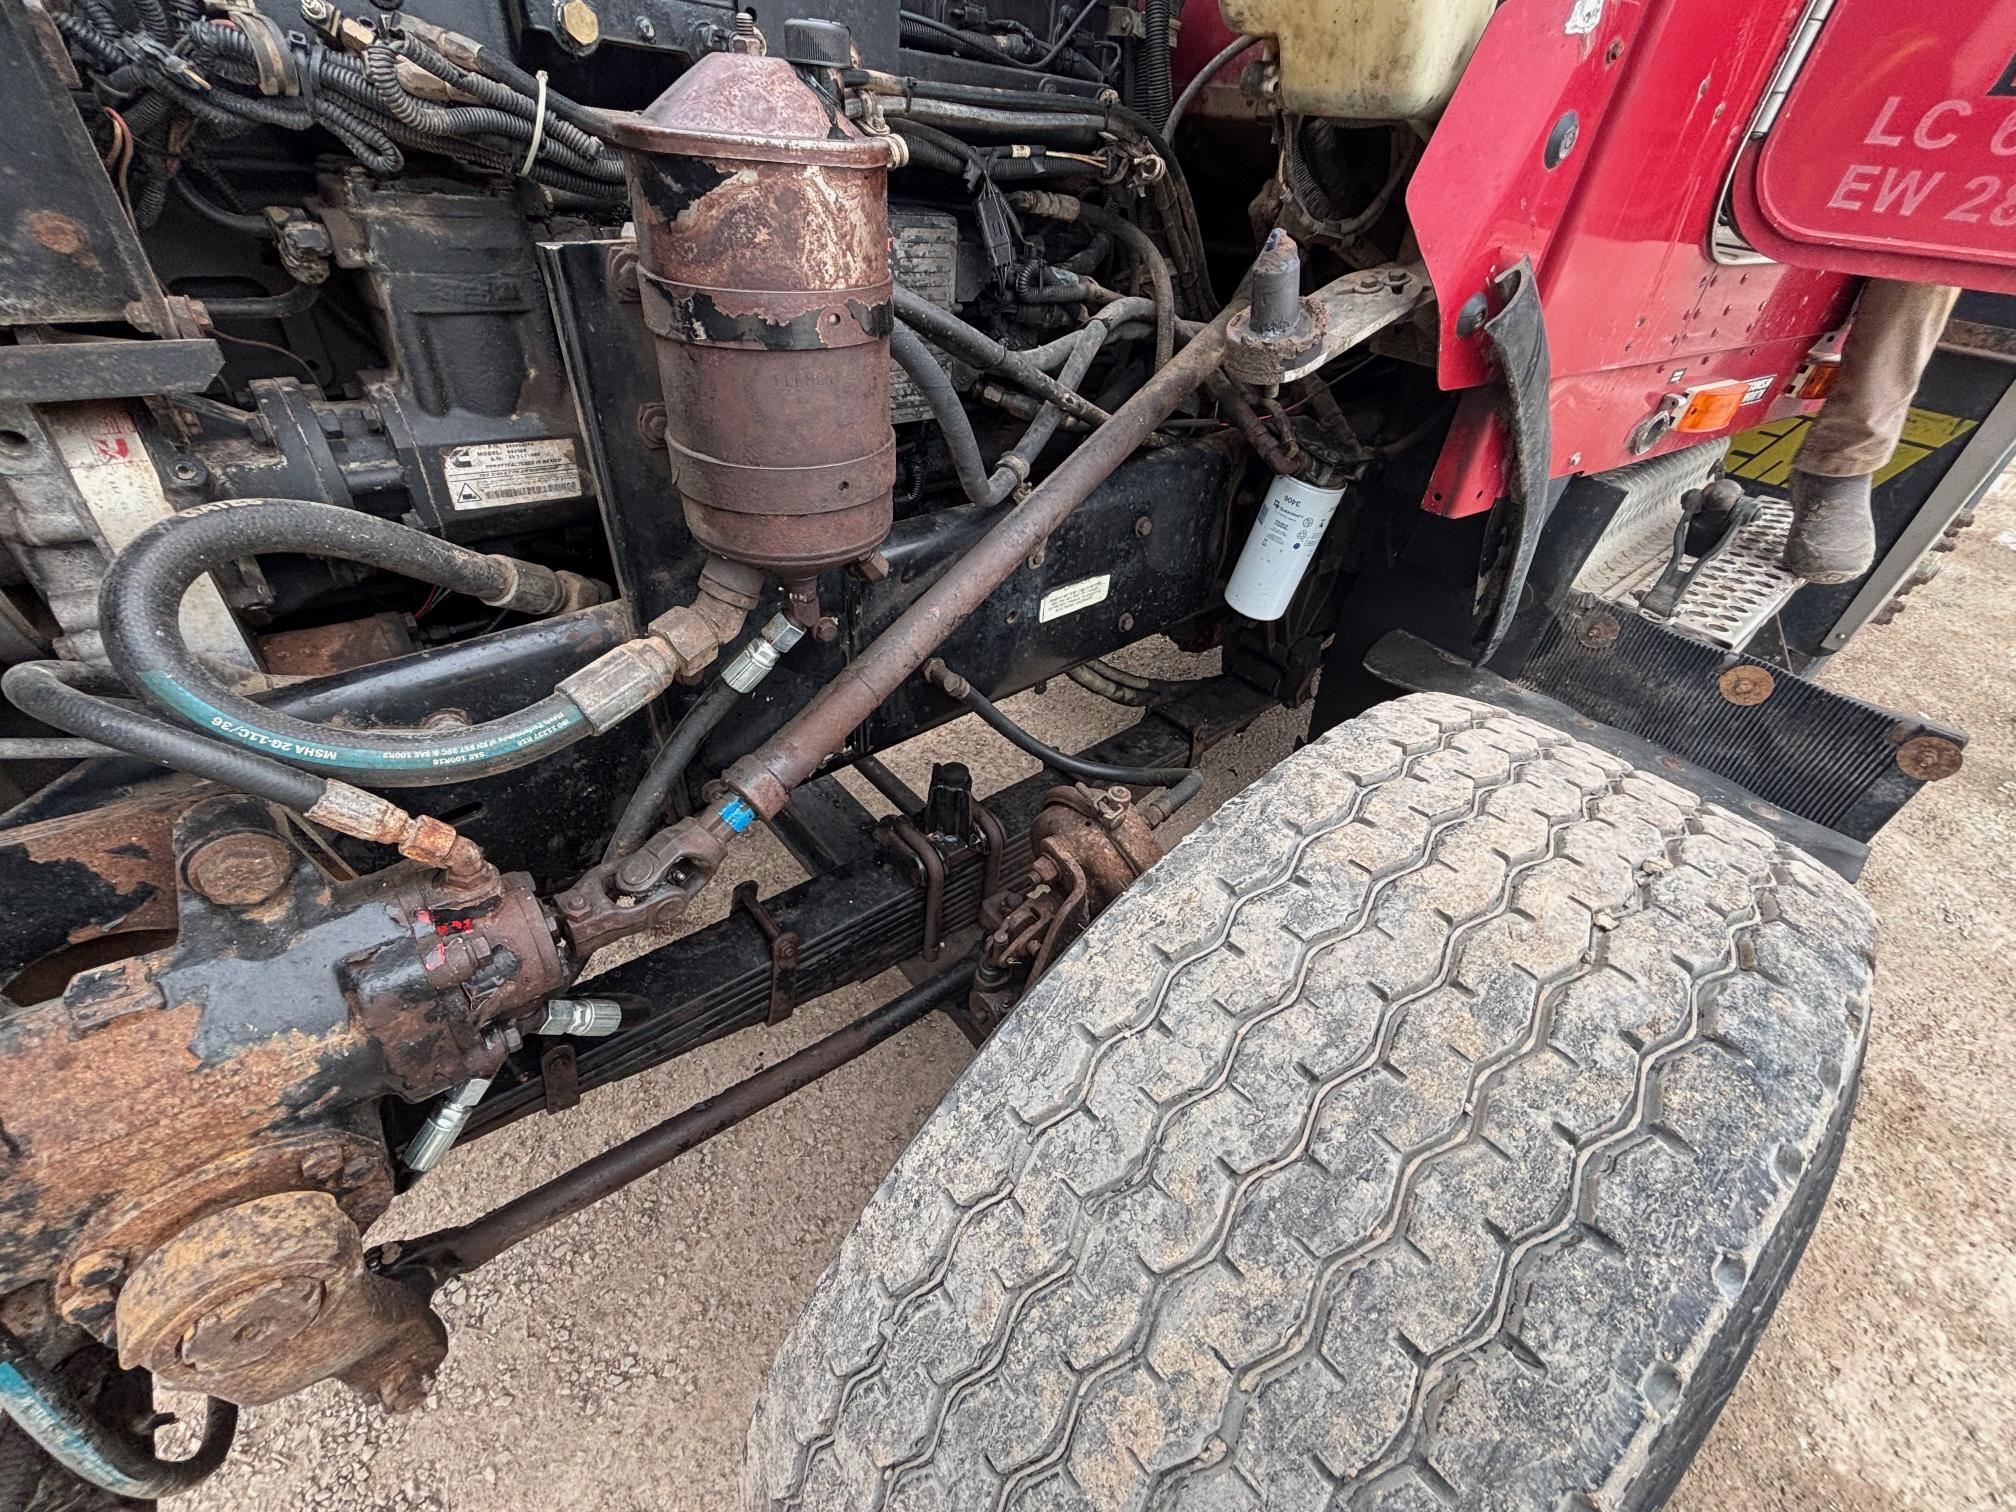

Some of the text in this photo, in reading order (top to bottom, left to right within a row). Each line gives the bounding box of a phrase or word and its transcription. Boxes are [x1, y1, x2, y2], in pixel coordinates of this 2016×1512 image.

[1863, 96, 1973, 149] LC
[1827, 164, 1946, 216] EW
[210, 716, 337, 760] MSHA 2G-11C/36
[383, 751, 413, 759] 100R2
[414, 749, 431, 758] SAE
[433, 753, 467, 766] 100R16
[467, 751, 485, 763] SAE
